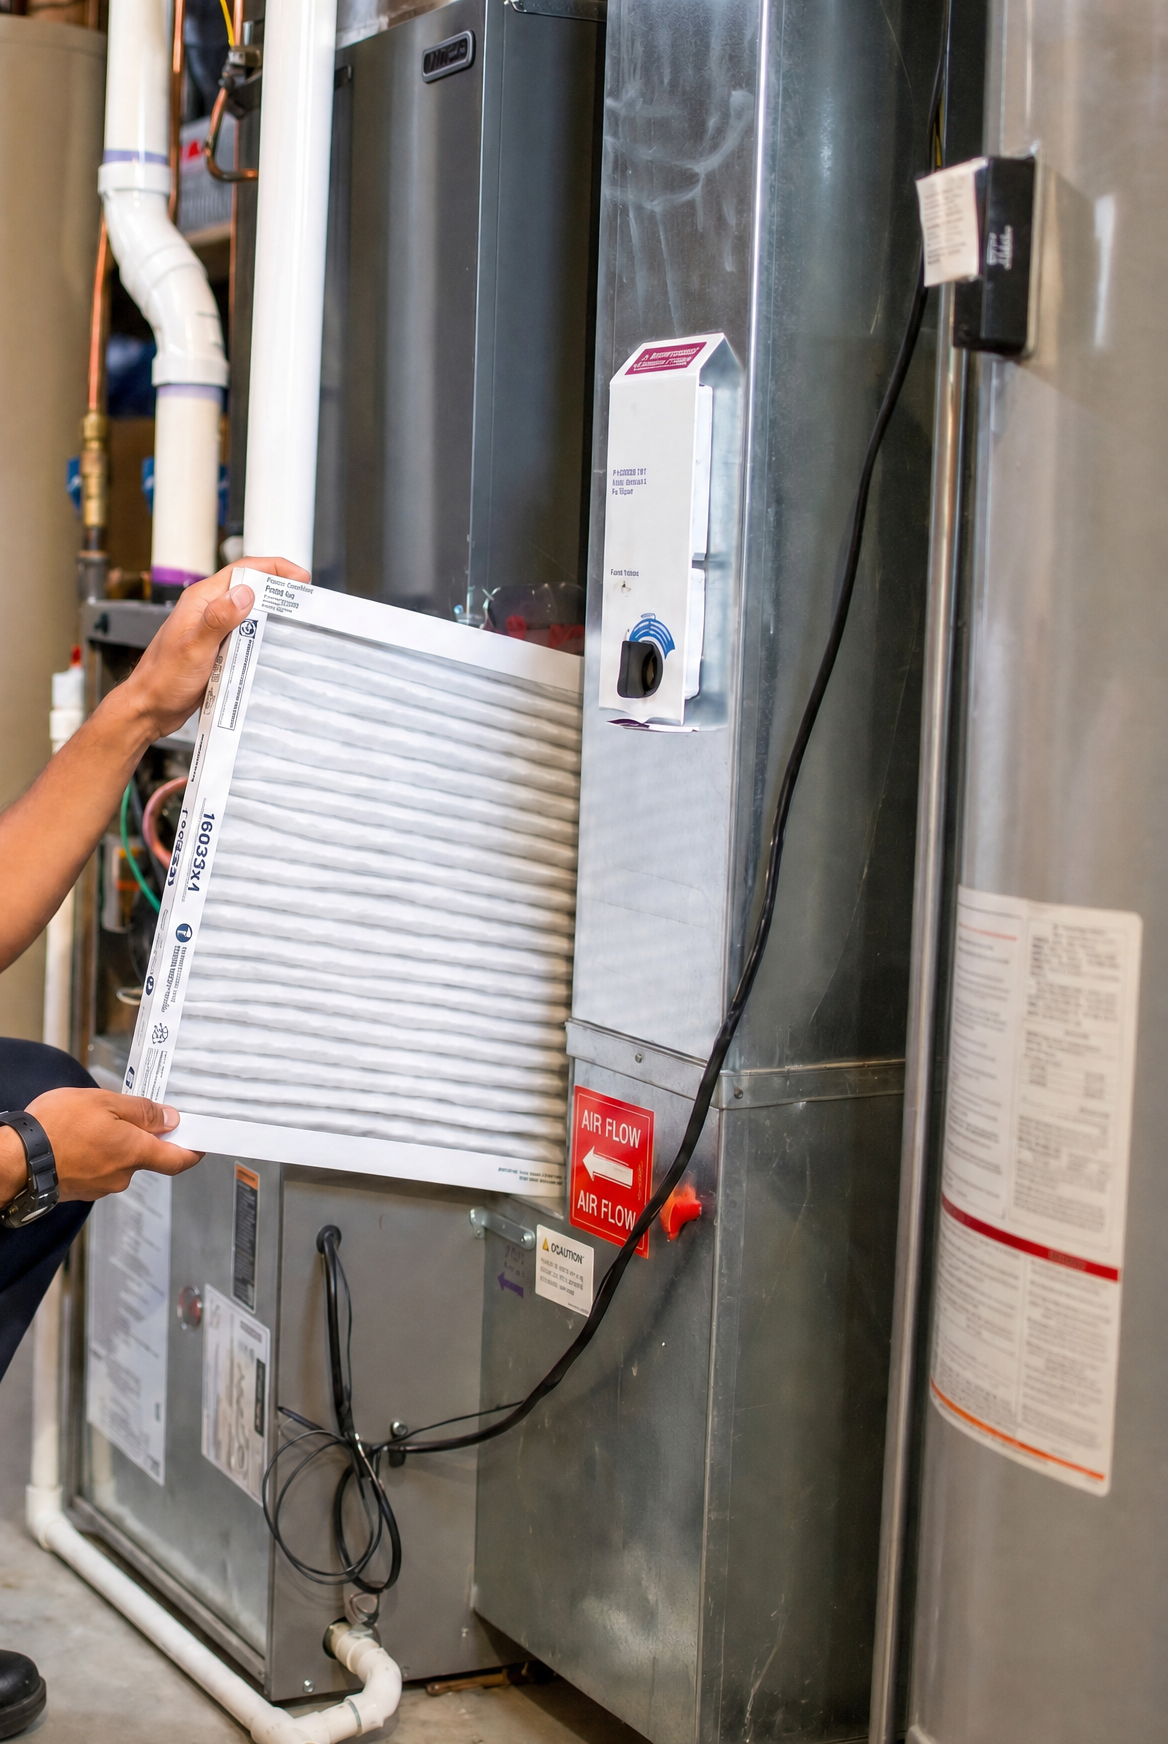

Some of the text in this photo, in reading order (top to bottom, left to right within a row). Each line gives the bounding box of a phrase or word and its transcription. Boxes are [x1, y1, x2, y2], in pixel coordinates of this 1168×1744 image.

[581, 1109, 641, 1149] AIR FLOW
[577, 1189, 637, 1232] AIR FLOW
